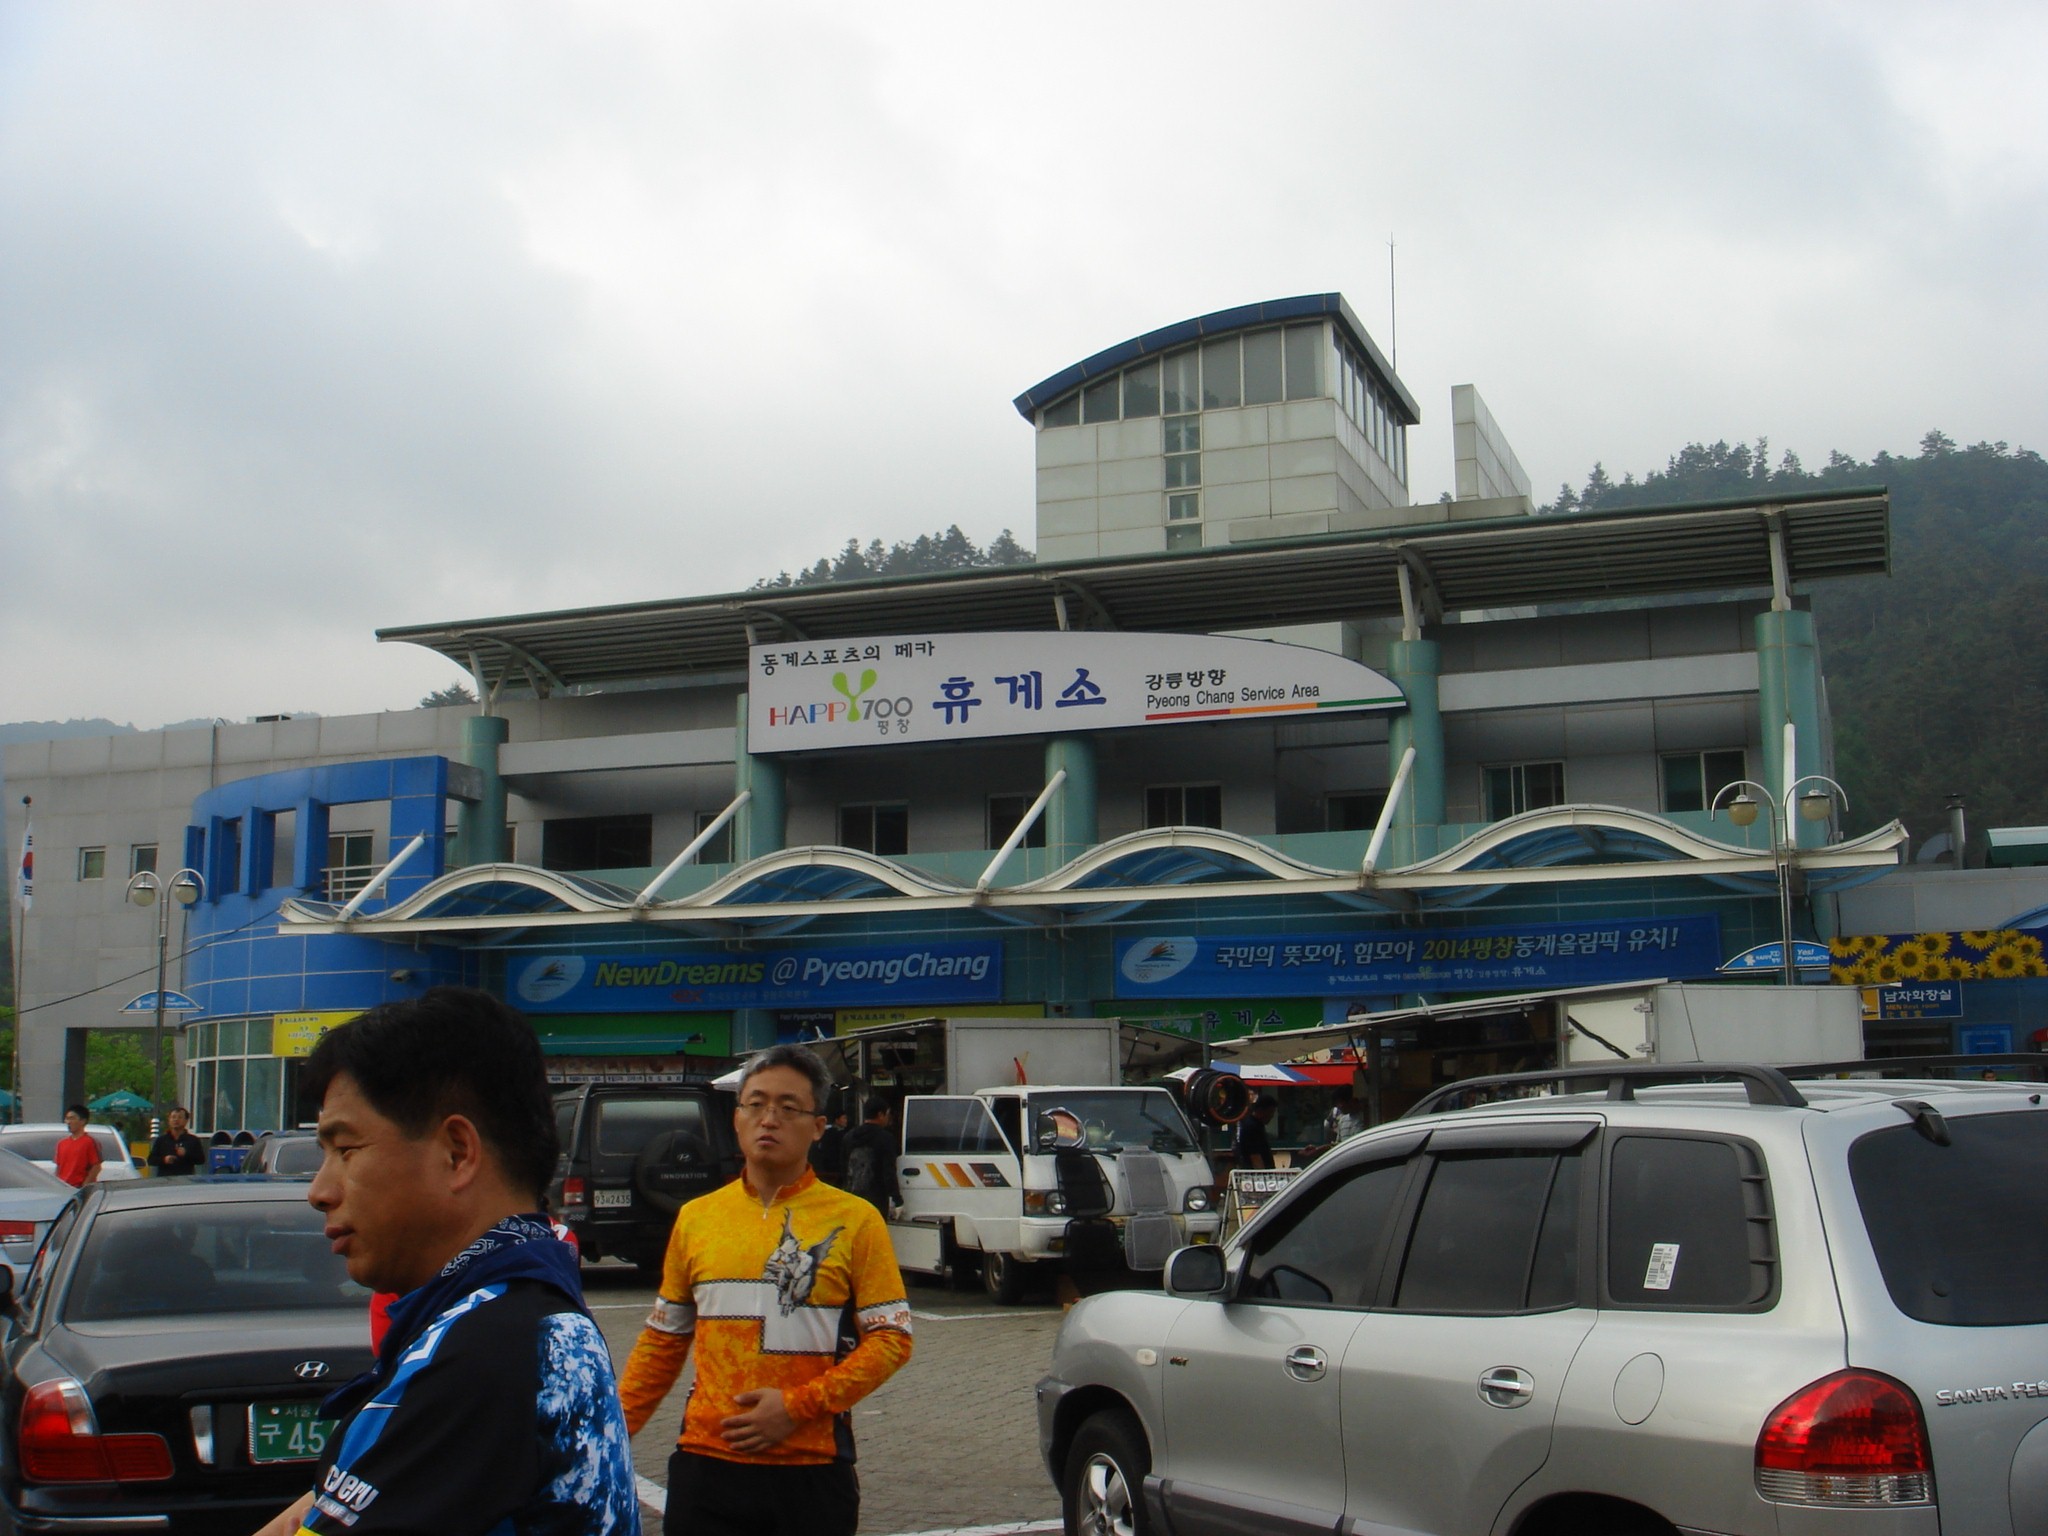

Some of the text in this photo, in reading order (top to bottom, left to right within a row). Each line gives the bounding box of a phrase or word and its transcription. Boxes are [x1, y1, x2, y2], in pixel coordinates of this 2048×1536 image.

[761, 641, 935, 676] 동계스포츠의 메카
[1145, 669, 1226, 690] 강릉방향
[932, 668, 1107, 725] 휴게소
[1147, 683, 1320, 709] Pyeong Chang Service Area
[877, 719, 910, 735] 평창
[1216, 945, 1275, 968] 국민의
[1282, 943, 1347, 967] 뜻모아,
[1354, 940, 1415, 964] 힘모아
[1627, 927, 1679, 952] 유치!
[594, 952, 991, 988] NewDreams @ PyeongChang
[1884, 988, 1952, 1003] 남자화장실
[660, 1172, 709, 1180] INNOVATION
[1936, 1385, 2008, 1407] SANTA
[259, 1423, 282, 1445] 구
